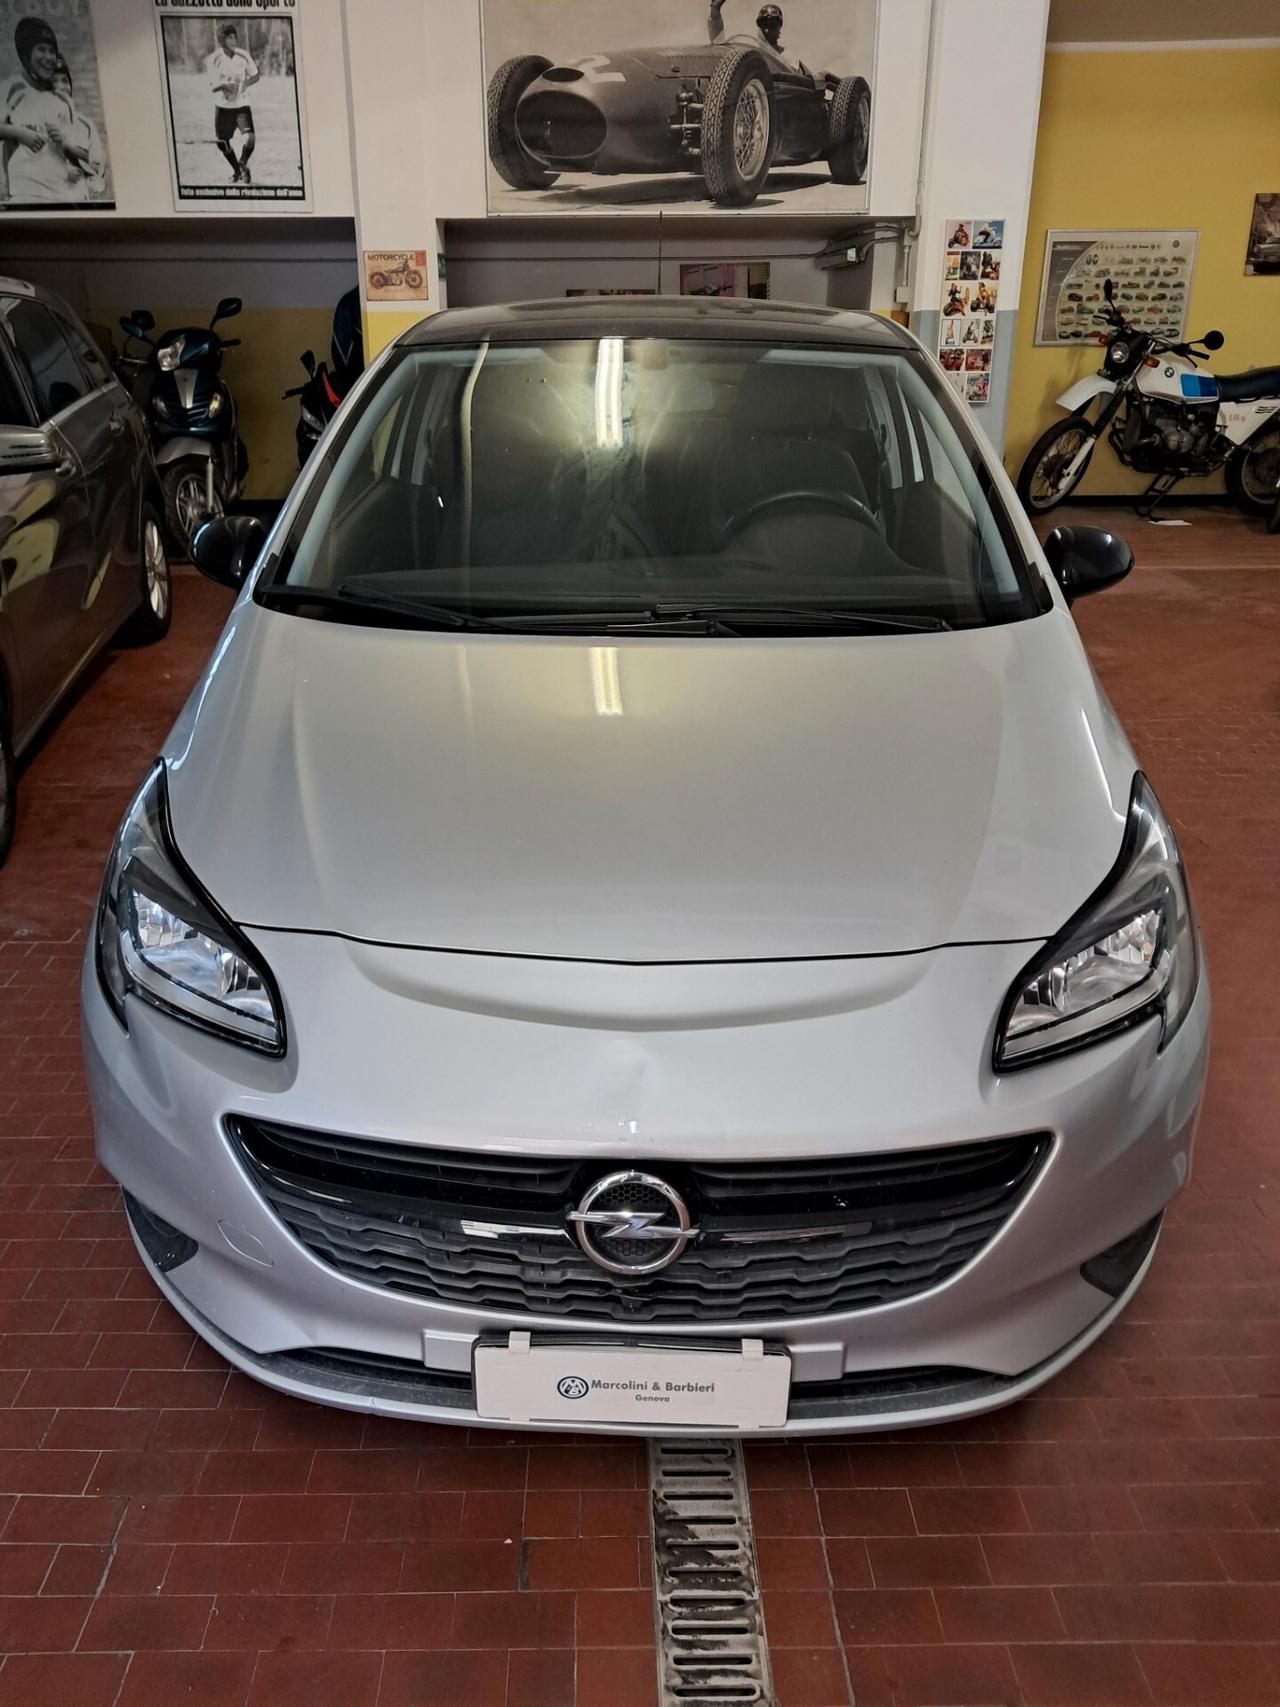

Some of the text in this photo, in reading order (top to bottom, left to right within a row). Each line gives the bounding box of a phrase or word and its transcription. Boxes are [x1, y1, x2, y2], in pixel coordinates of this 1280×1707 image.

[591, 1379, 715, 1393] Marcolini & Barbieri
[635, 1394, 671, 1403] Genova
